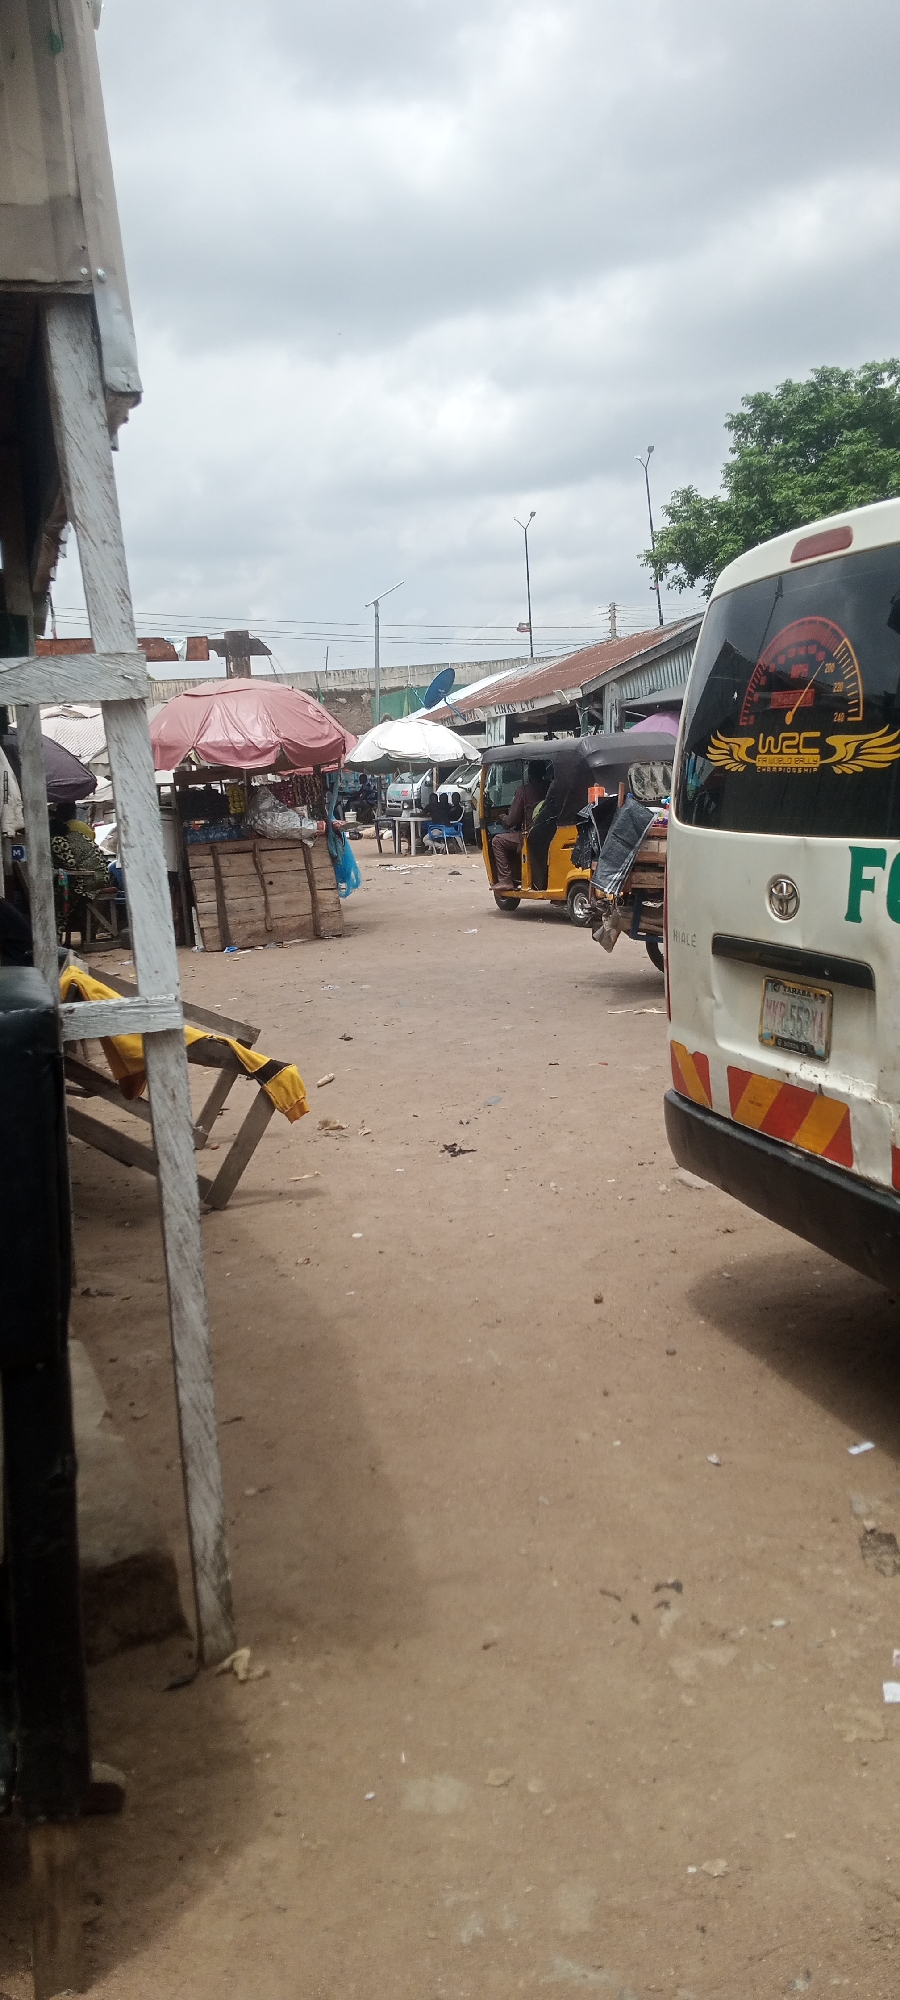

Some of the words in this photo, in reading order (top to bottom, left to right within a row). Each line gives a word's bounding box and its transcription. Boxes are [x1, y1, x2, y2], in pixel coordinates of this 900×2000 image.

[494, 702, 516, 715] LINKS
[833, 712, 845, 723] 240
[758, 732, 821, 754] WRC
[767, 757, 792, 765] WORLD
[794, 757, 818, 765] RALLY
[756, 766, 818, 774] CHAMPIONSHIP
[783, 985, 812, 999] TARABA
